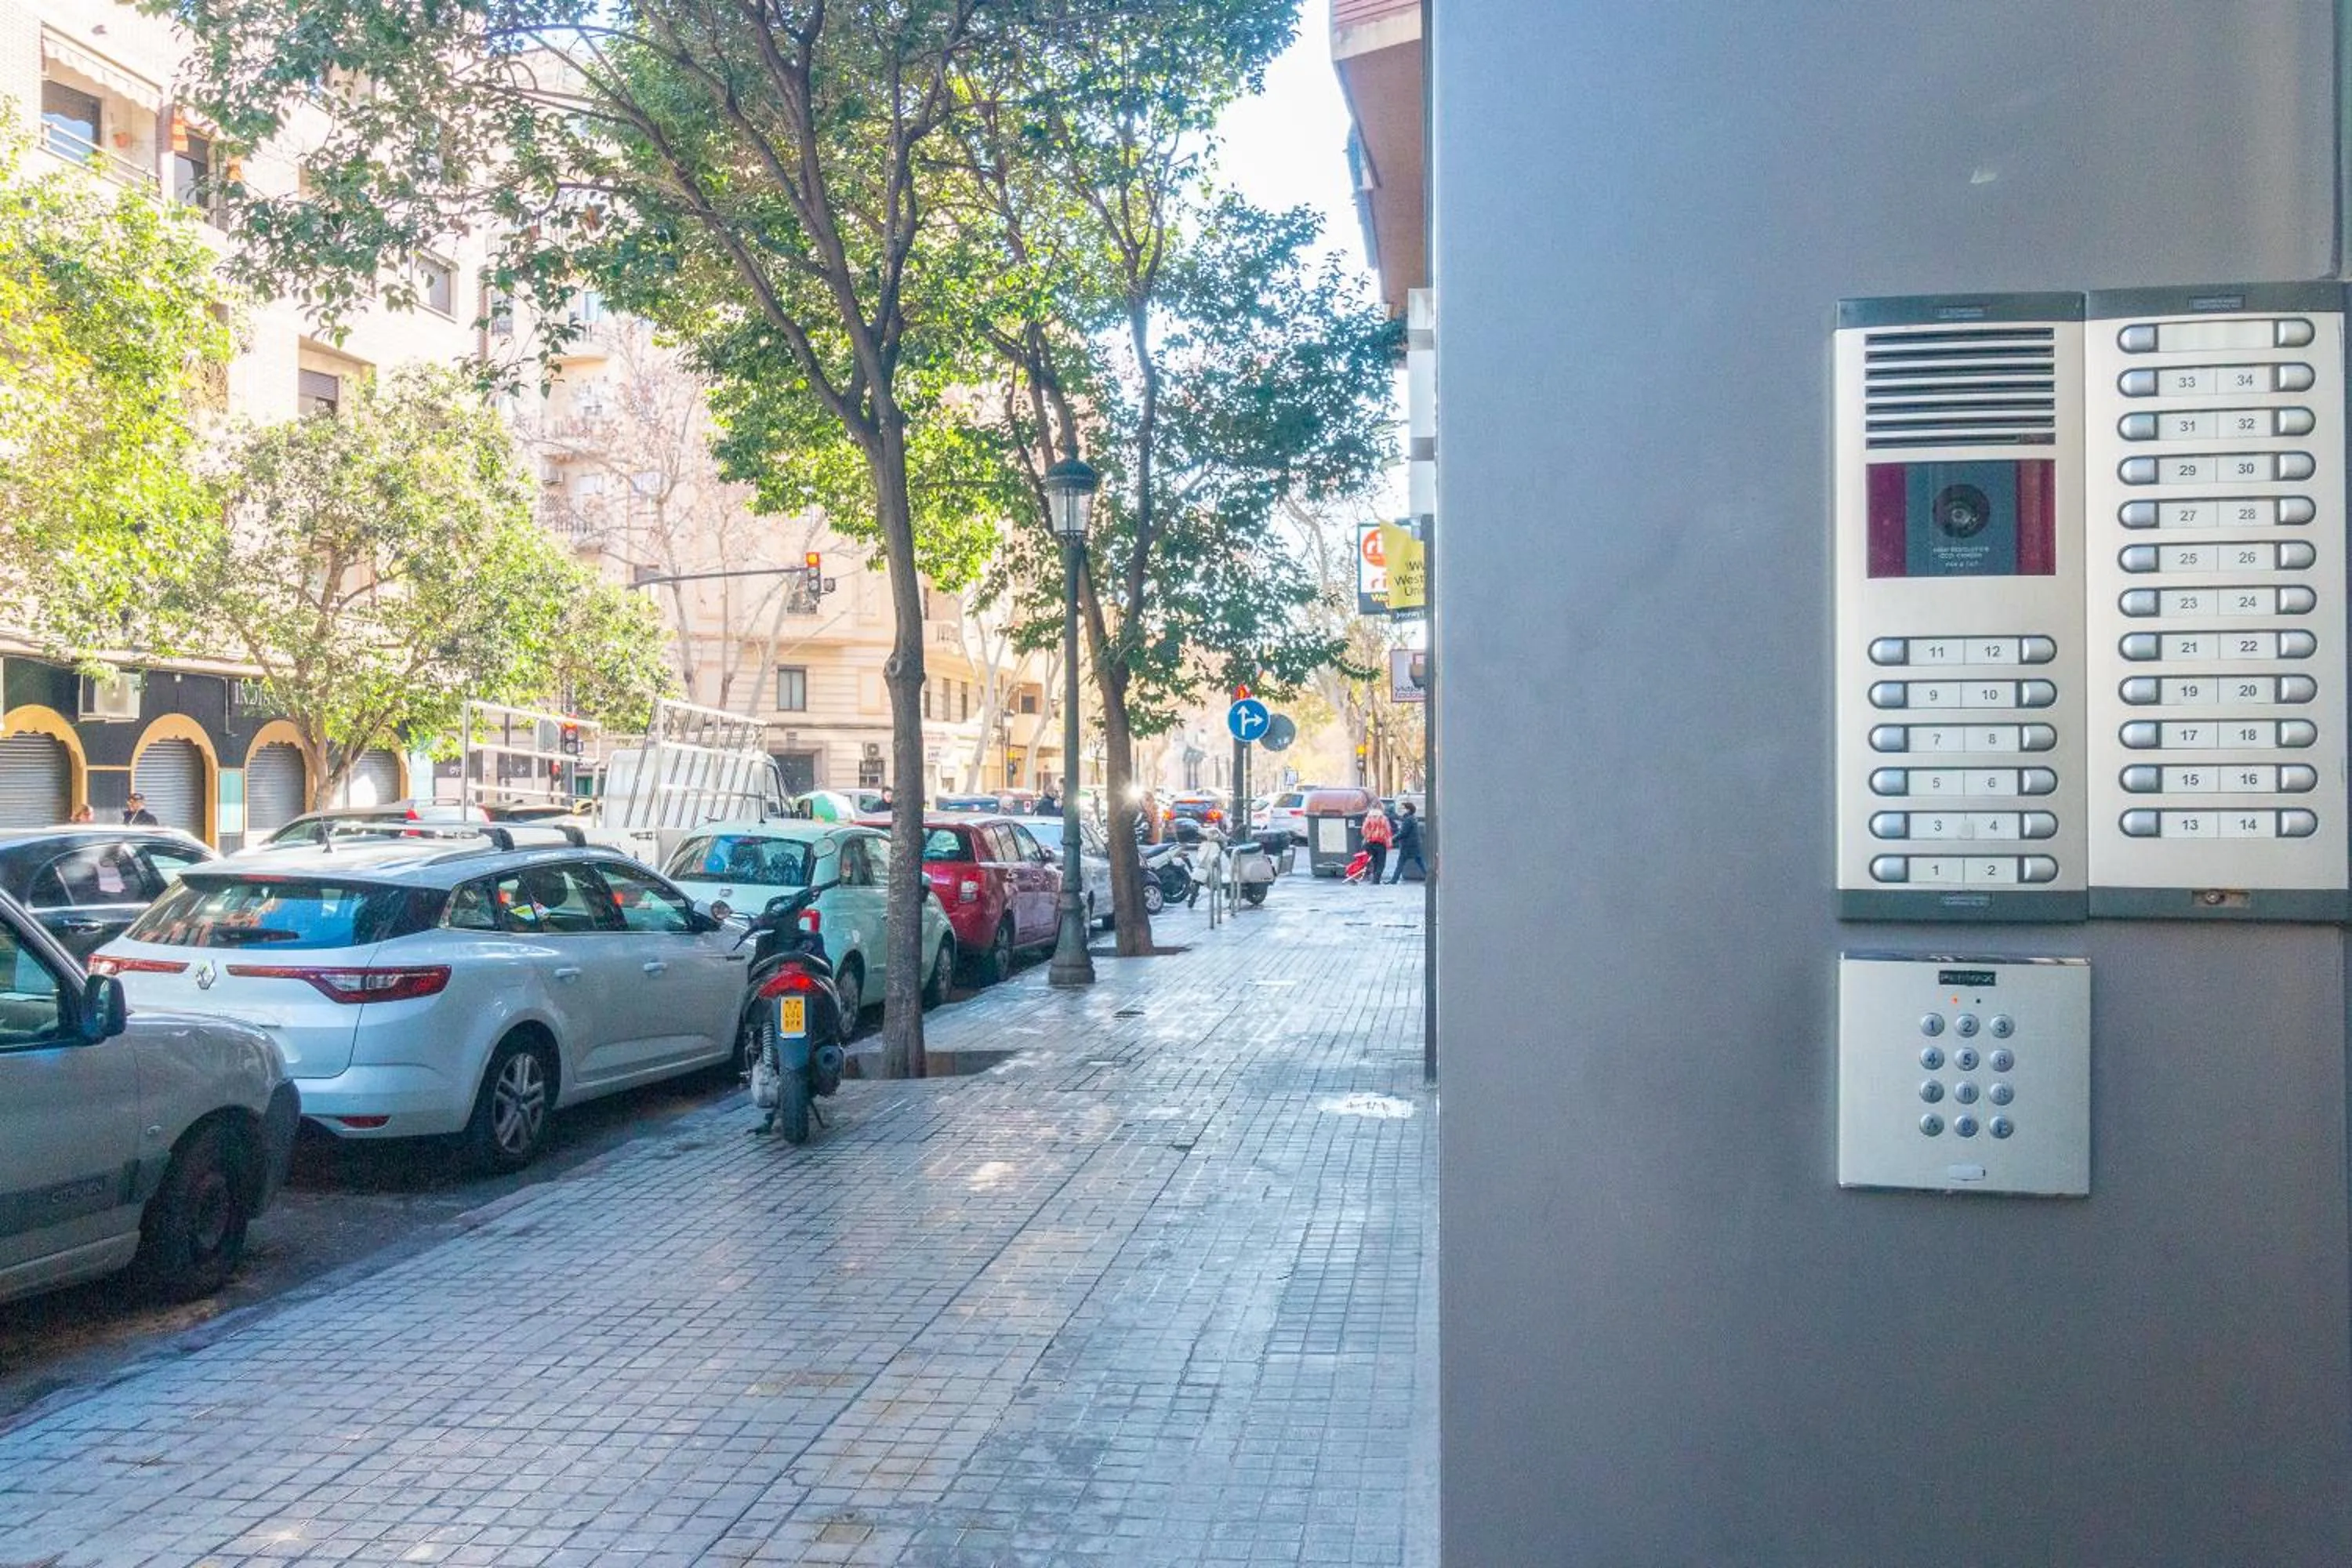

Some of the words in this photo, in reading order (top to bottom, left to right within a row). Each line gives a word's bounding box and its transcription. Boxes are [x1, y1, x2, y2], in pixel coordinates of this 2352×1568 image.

[2178, 376, 2196, 388] 33
[2237, 374, 2253, 387] 34
[2180, 419, 2196, 432] 31
[2238, 417, 2255, 430] 32
[2179, 464, 2197, 476] 29
[2238, 462, 2255, 474] 30
[2180, 510, 2197, 522] 27
[2238, 507, 2256, 520] 28
[2180, 553, 2198, 565] 25
[2238, 551, 2256, 564] 26
[1394, 574, 1425, 586] West
[2180, 597, 2198, 609] 23
[2238, 595, 2257, 608] 24
[1929, 646, 1944, 658] 11
[1984, 645, 2000, 658] 12
[2181, 641, 2198, 653] 21
[2240, 640, 2258, 652] 22
[1929, 689, 1938, 702] 9
[1982, 689, 1998, 700] 10
[2180, 685, 2198, 697] 19
[2238, 684, 2257, 697] 20
[1933, 733, 1941, 746] 7
[1987, 733, 1997, 745] 8
[2180, 729, 2198, 741] 17
[2239, 728, 2257, 741] 18
[1932, 777, 1941, 789] 5
[1987, 777, 1996, 788] 6
[2182, 774, 2199, 786] 15
[2240, 773, 2258, 786] 16
[1934, 819, 1943, 832] 3
[1989, 819, 1998, 832] 4
[2182, 818, 2199, 831] 13
[2240, 818, 2257, 830] 14
[1931, 865, 1939, 876] 1
[1987, 865, 1996, 876] 2
